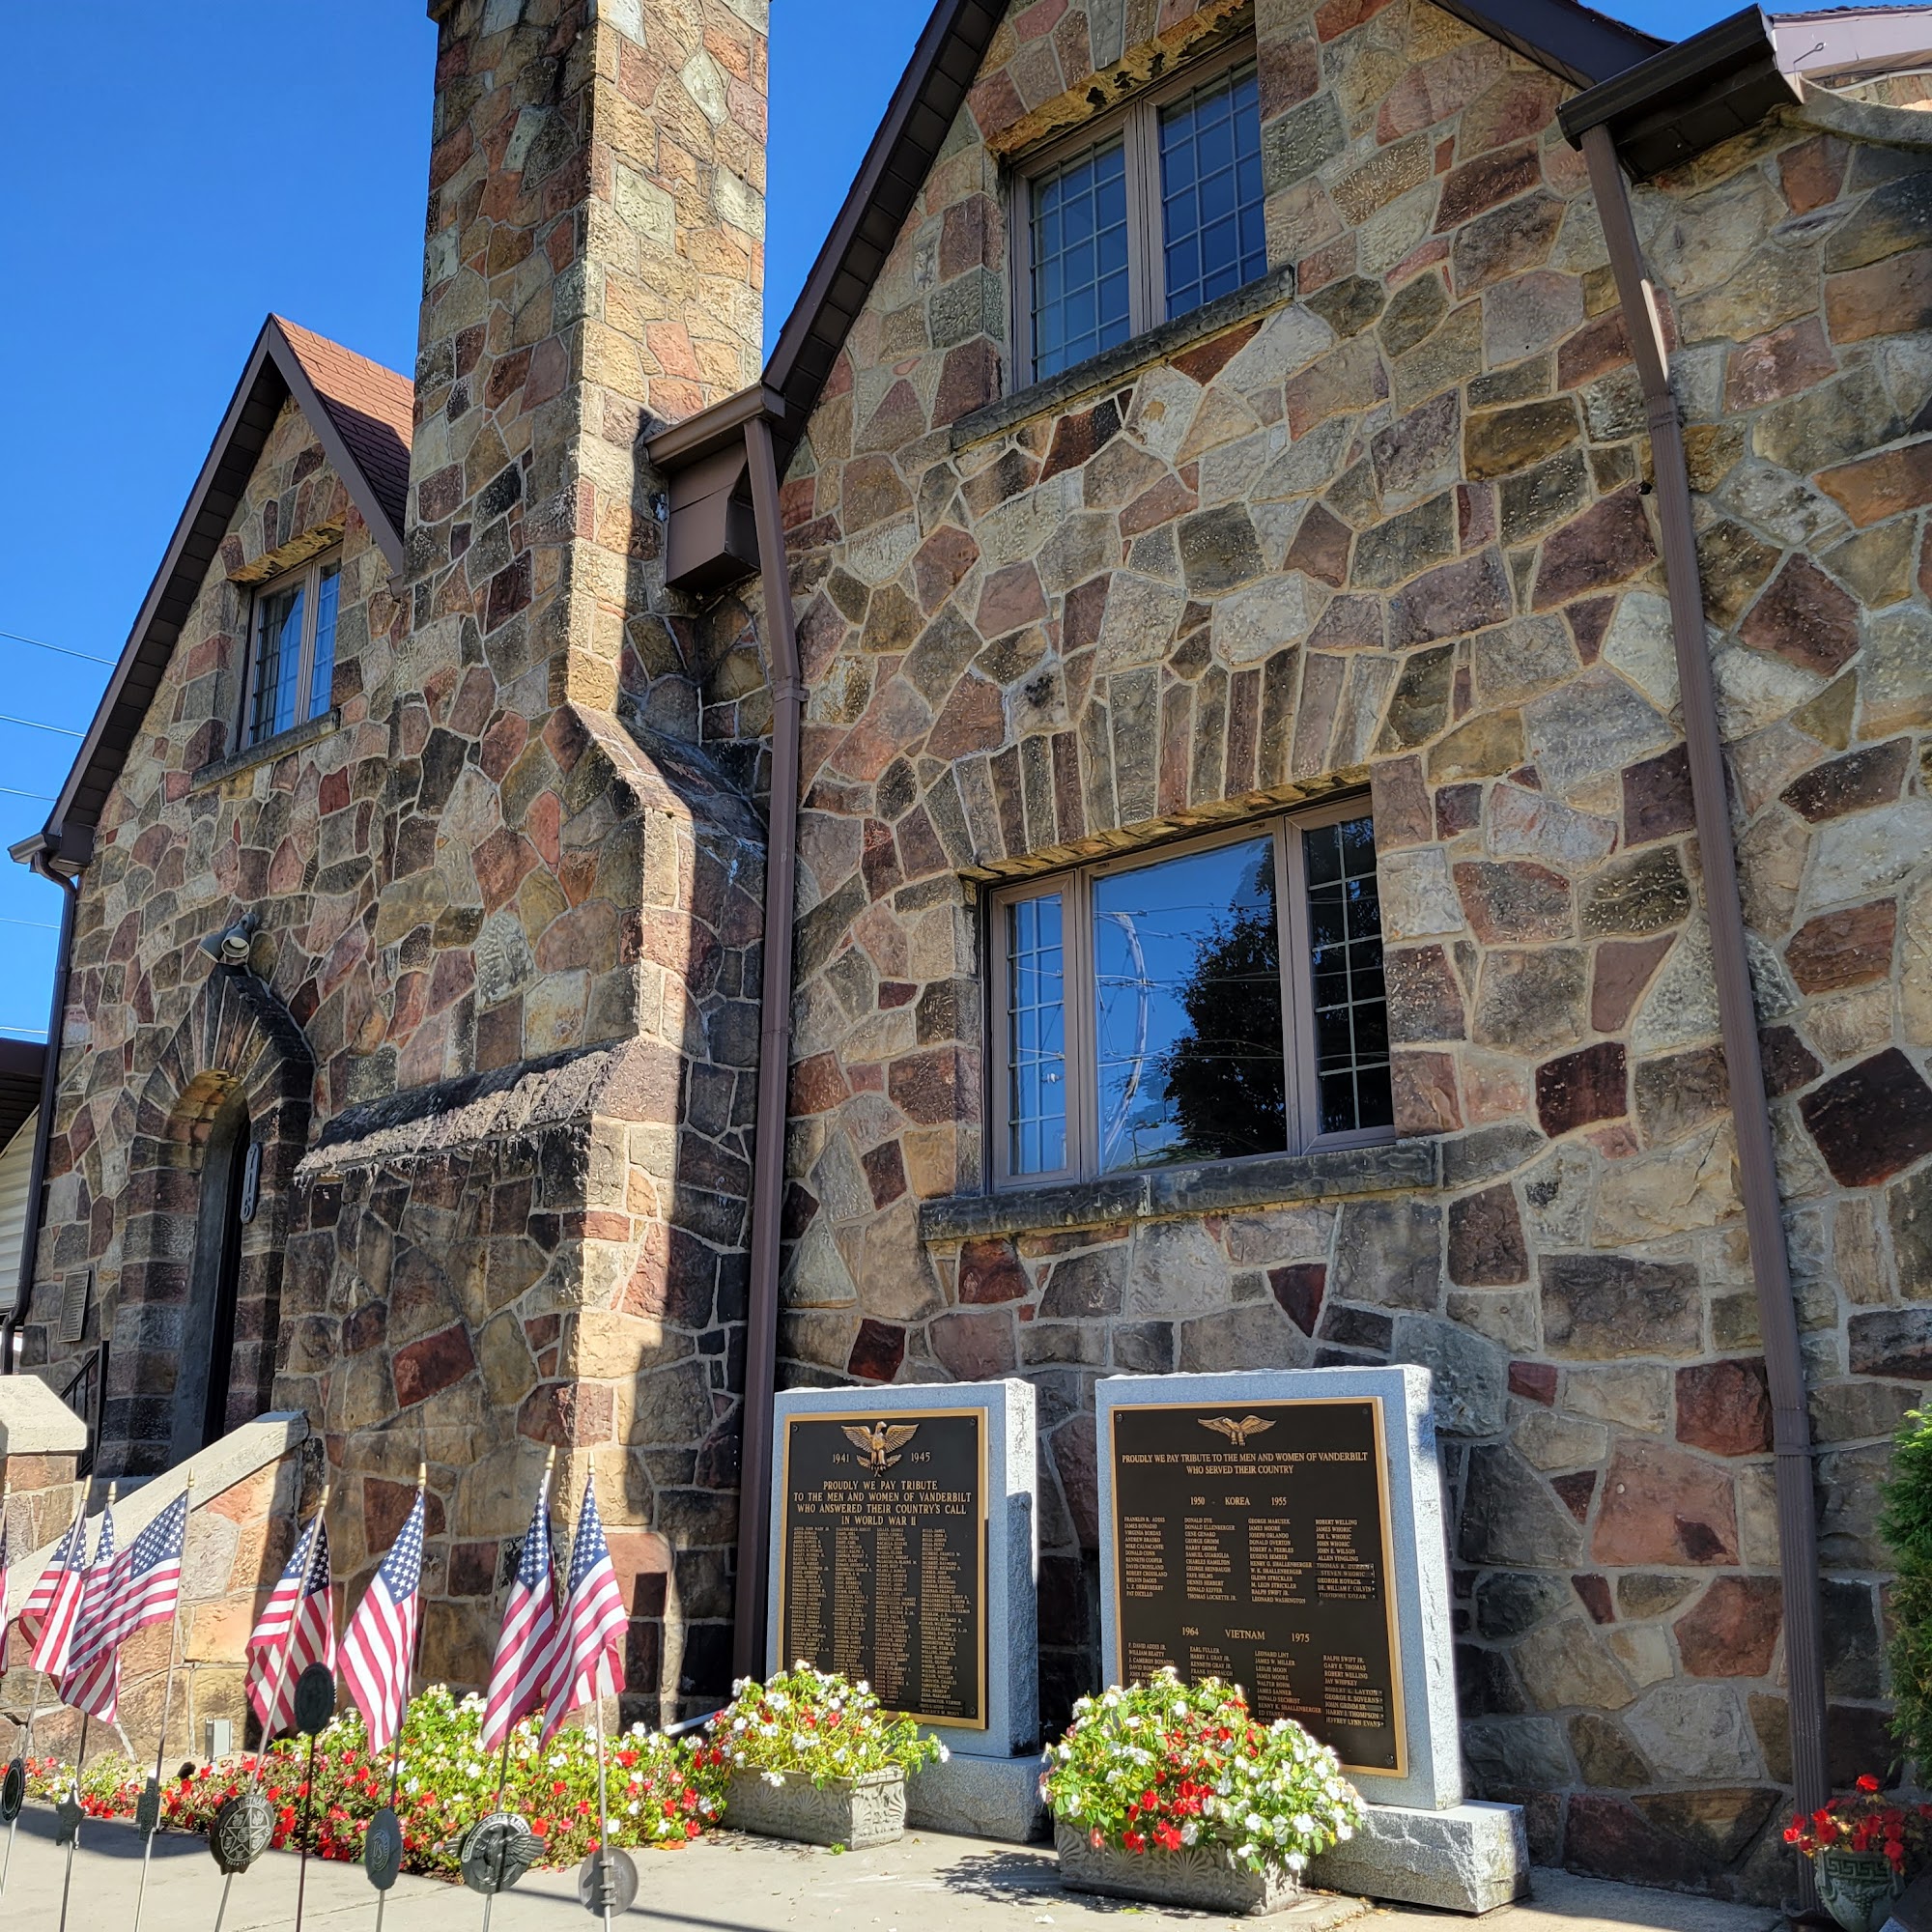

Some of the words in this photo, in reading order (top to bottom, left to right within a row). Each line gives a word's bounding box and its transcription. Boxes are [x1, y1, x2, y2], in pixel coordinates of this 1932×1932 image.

[244, 1148, 257, 1218] 716
[833, 1453, 849, 1464] 1941
[911, 1452, 930, 1463] 1945
[1122, 1454, 1152, 1463] PROUDLY
[1154, 1454, 1165, 1463] WE
[1167, 1454, 1179, 1463] PAY
[1180, 1454, 1211, 1462] TRIBUTE
[1212, 1454, 1222, 1462] TO
[1223, 1454, 1237, 1462] THE
[1239, 1453, 1256, 1462] MEN
[1275, 1453, 1304, 1461] WOMEN
[1306, 1453, 1317, 1461] OF
[1318, 1452, 1367, 1461] VANDERBILT
[1186, 1466, 1204, 1474] WHO
[1205, 1465, 1233, 1474] SERVED
[1234, 1465, 1256, 1474] THEIR
[1258, 1465, 1294, 1473] COUNTRY
[823, 1481, 858, 1490] PROUDLY
[864, 1481, 875, 1490] WE
[881, 1481, 895, 1490] PAY
[901, 1481, 937, 1490] TRIBUTE
[794, 1492, 804, 1502] TO
[808, 1492, 823, 1502] THE
[827, 1492, 843, 1502] MEN
[848, 1492, 864, 1502] AND
[868, 1492, 899, 1502] WOMEN
[904, 1492, 914, 1502] OF
[919, 1492, 971, 1502] VANDERBILT
[1190, 1497, 1205, 1505] 1950
[1225, 1497, 1250, 1505] KOREA
[1271, 1497, 1287, 1505] 1955
[797, 1504, 815, 1513] WHO
[819, 1504, 862, 1513] ANSWERED
[867, 1504, 891, 1513] THEIR
[895, 1503, 940, 1514] COUNTRY'S
[945, 1504, 966, 1514] CALL
[842, 1516, 850, 1525] IN
[855, 1516, 883, 1525] WORLD
[889, 1516, 907, 1525] WAR
[911, 1516, 916, 1525] II
[1182, 1627, 1199, 1636] 1964
[1225, 1629, 1265, 1640] VIETNAM
[1291, 1633, 1309, 1643] 1975
[237, 1797, 269, 1809] VIETNAM
[219, 1828, 226, 1837] U
[265, 1828, 271, 1836] S
